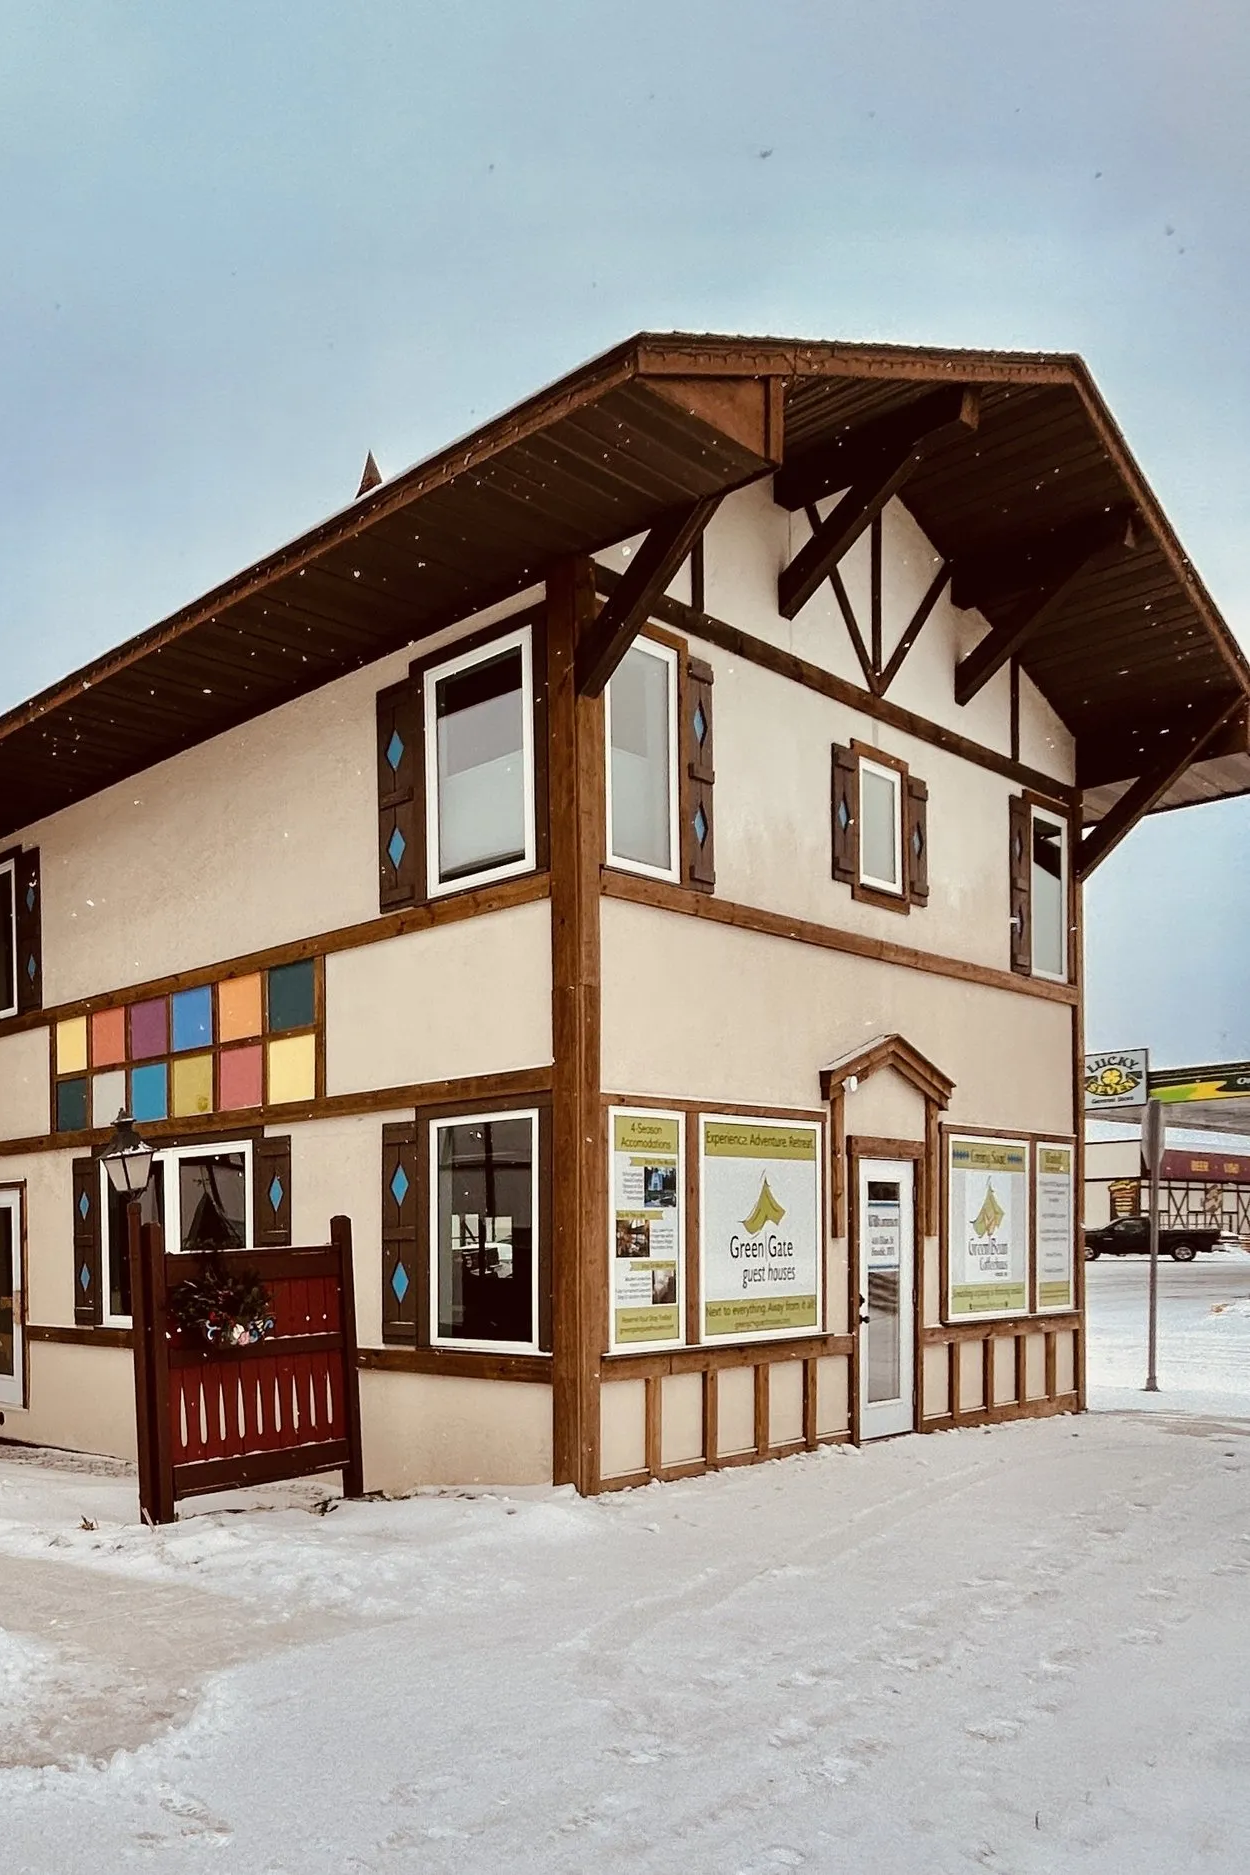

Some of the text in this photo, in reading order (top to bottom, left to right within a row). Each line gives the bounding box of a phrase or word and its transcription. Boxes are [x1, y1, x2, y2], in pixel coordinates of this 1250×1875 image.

[1086, 1056, 1139, 1073] LUCKY
[1087, 1079, 1136, 1095] SEVEN
[620, 1137, 671, 1150] Accomodations
[730, 1235, 794, 1258] Green Gate
[742, 1263, 796, 1289] guest houses
[723, 1307, 731, 1316] to
[785, 1300, 799, 1310] from
